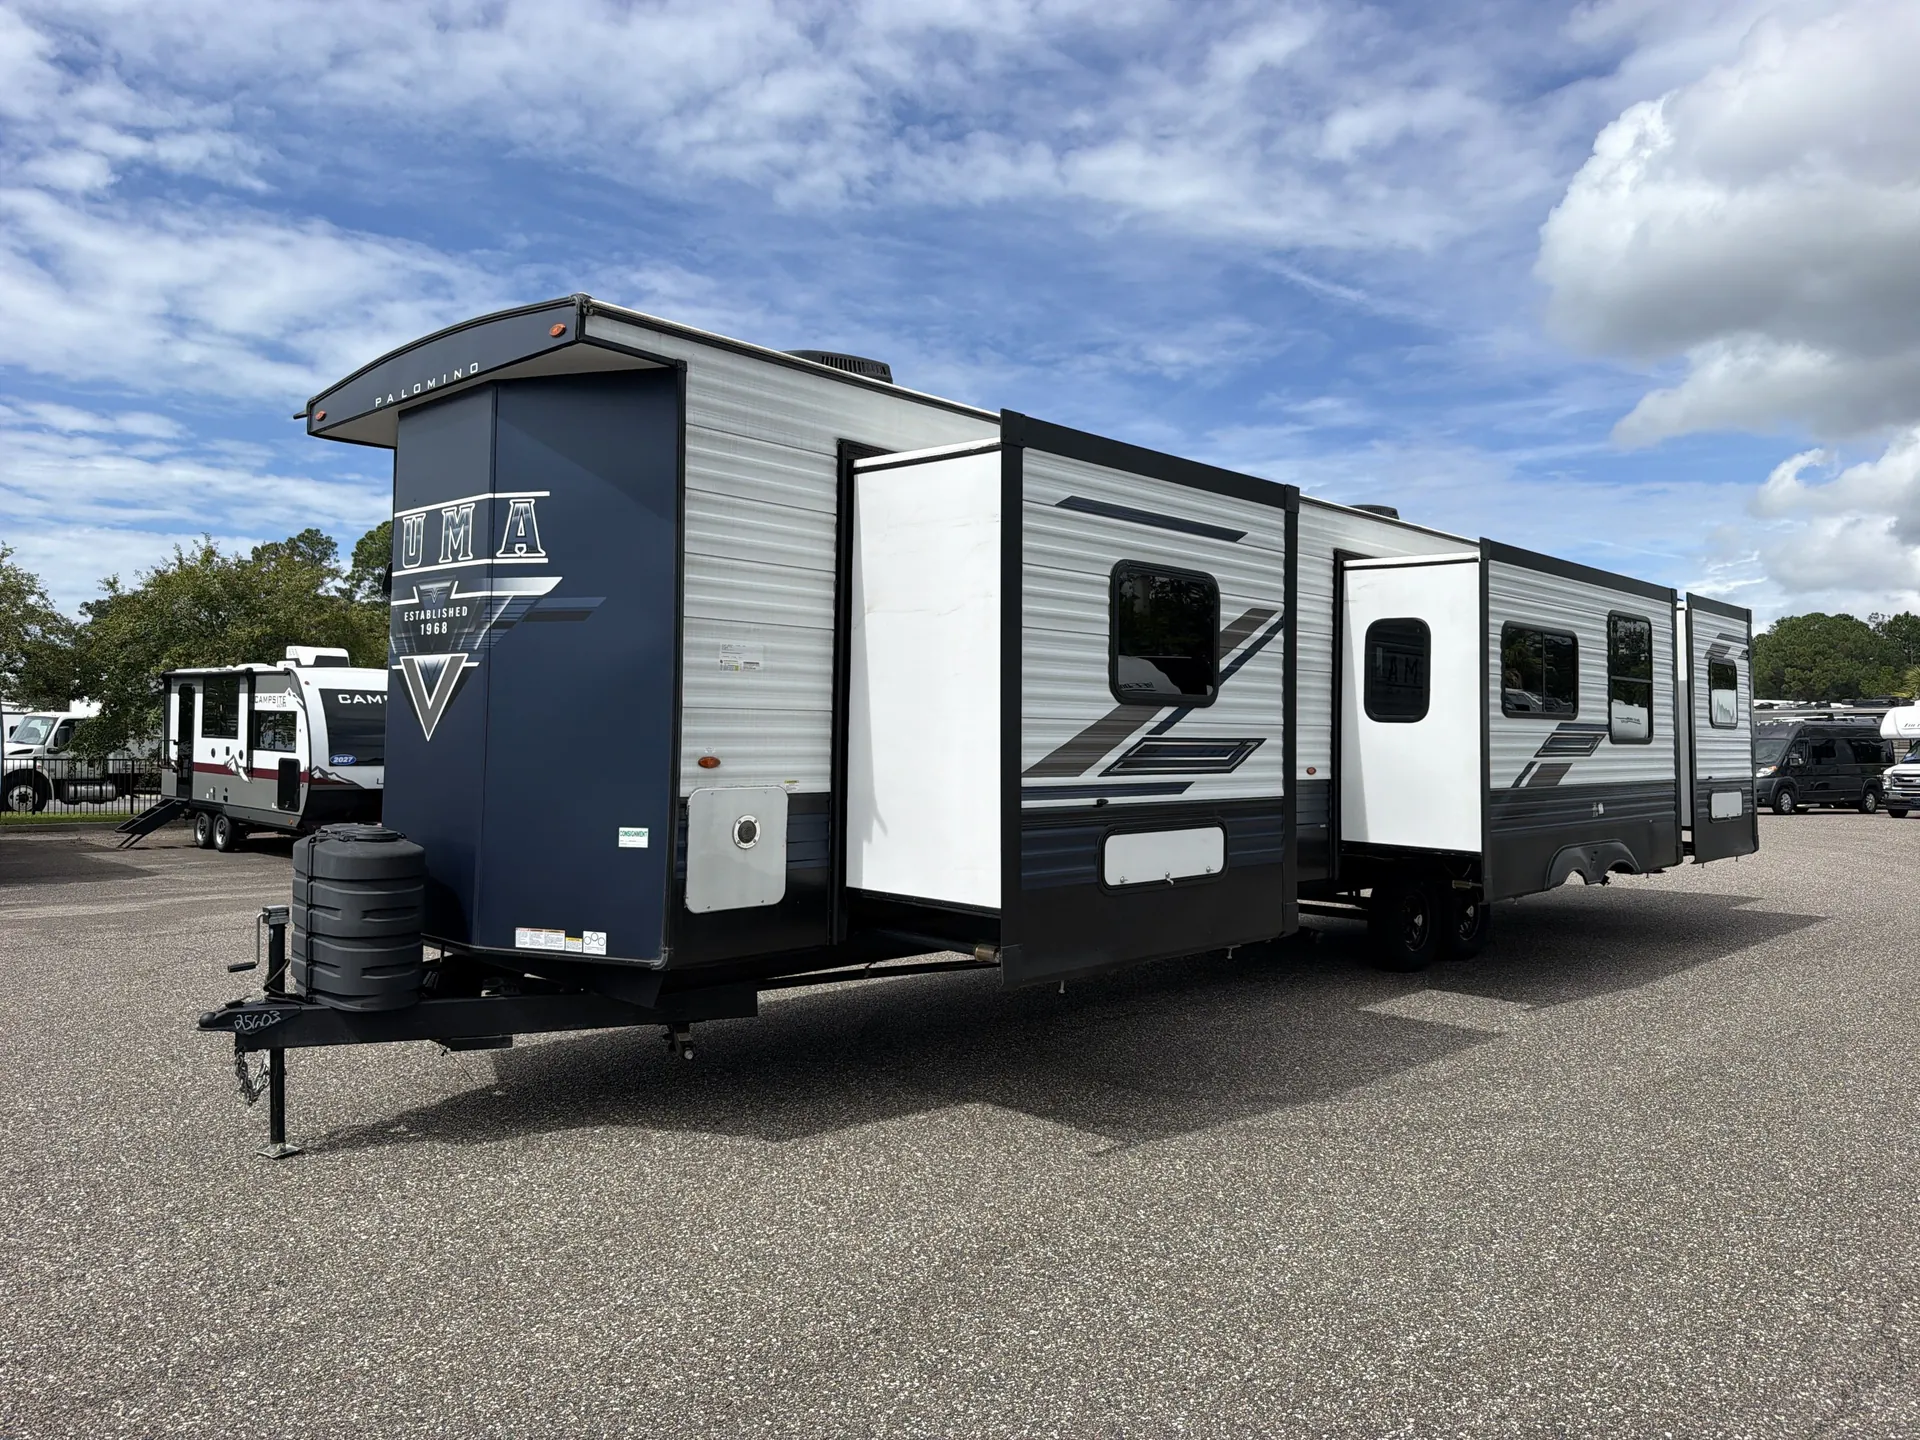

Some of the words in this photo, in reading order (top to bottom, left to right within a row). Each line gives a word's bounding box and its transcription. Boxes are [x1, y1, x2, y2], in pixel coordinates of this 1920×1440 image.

[375, 362, 479, 407] PALOMINO
[404, 606, 468, 622] ESTABLISHED
[420, 621, 448, 635] 1968
[254, 695, 287, 704] CAMPSITE
[337, 694, 388, 704] CAM
[333, 755, 353, 764] 2027
